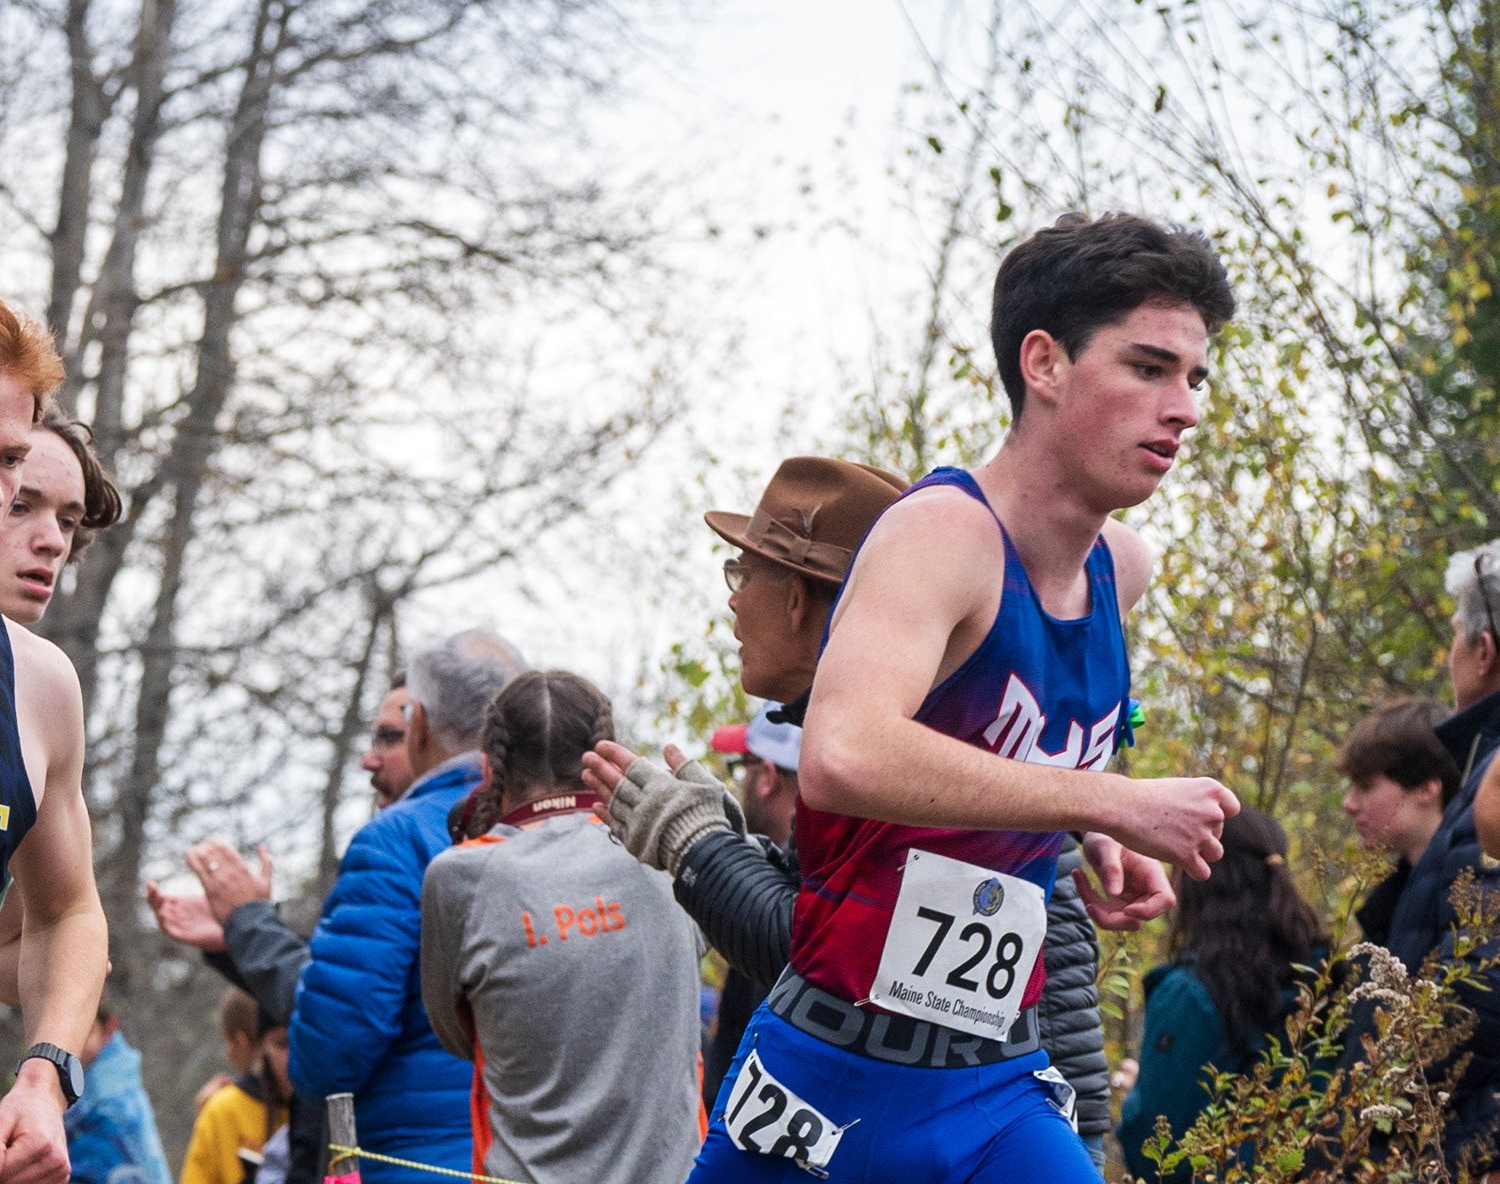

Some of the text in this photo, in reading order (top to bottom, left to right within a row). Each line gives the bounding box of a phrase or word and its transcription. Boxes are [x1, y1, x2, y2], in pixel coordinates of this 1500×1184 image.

[533, 795, 577, 813] Nikon
[553, 896, 627, 941] Pols
[911, 905, 1024, 1000] 728
[888, 981, 1006, 1028] Maine State Championship
[727, 1060, 823, 1164] 728
